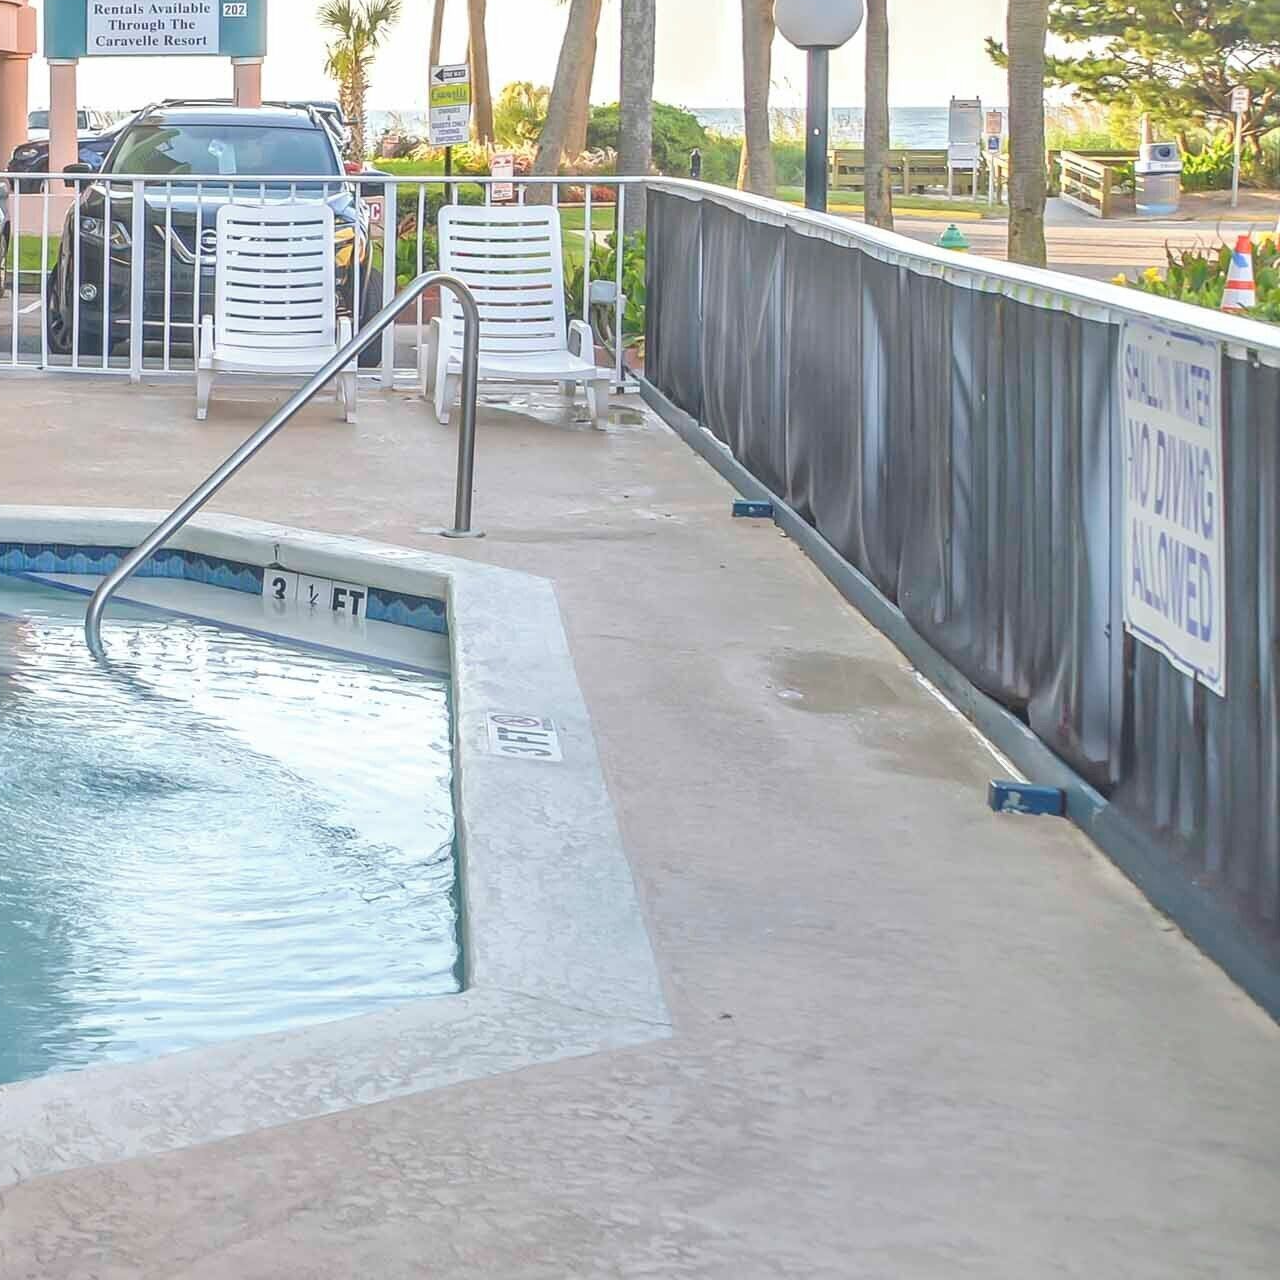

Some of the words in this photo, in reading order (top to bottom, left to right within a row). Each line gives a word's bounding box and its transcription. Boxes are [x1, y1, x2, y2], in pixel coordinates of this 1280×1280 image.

[94, 3, 144, 15] Rentals
[149, 2, 211, 14] Available
[224, 4, 245, 16] 202
[107, 19, 165, 32] Through
[170, 18, 196, 30] The
[95, 35, 159, 47] Caravelle
[164, 34, 208, 46] Resort
[1129, 418, 1151, 507] NO
[1155, 429, 1213, 540] DIVING
[1132, 518, 1213, 643] ALLOWED
[272, 577, 286, 599] 3
[332, 587, 365, 616] FT
